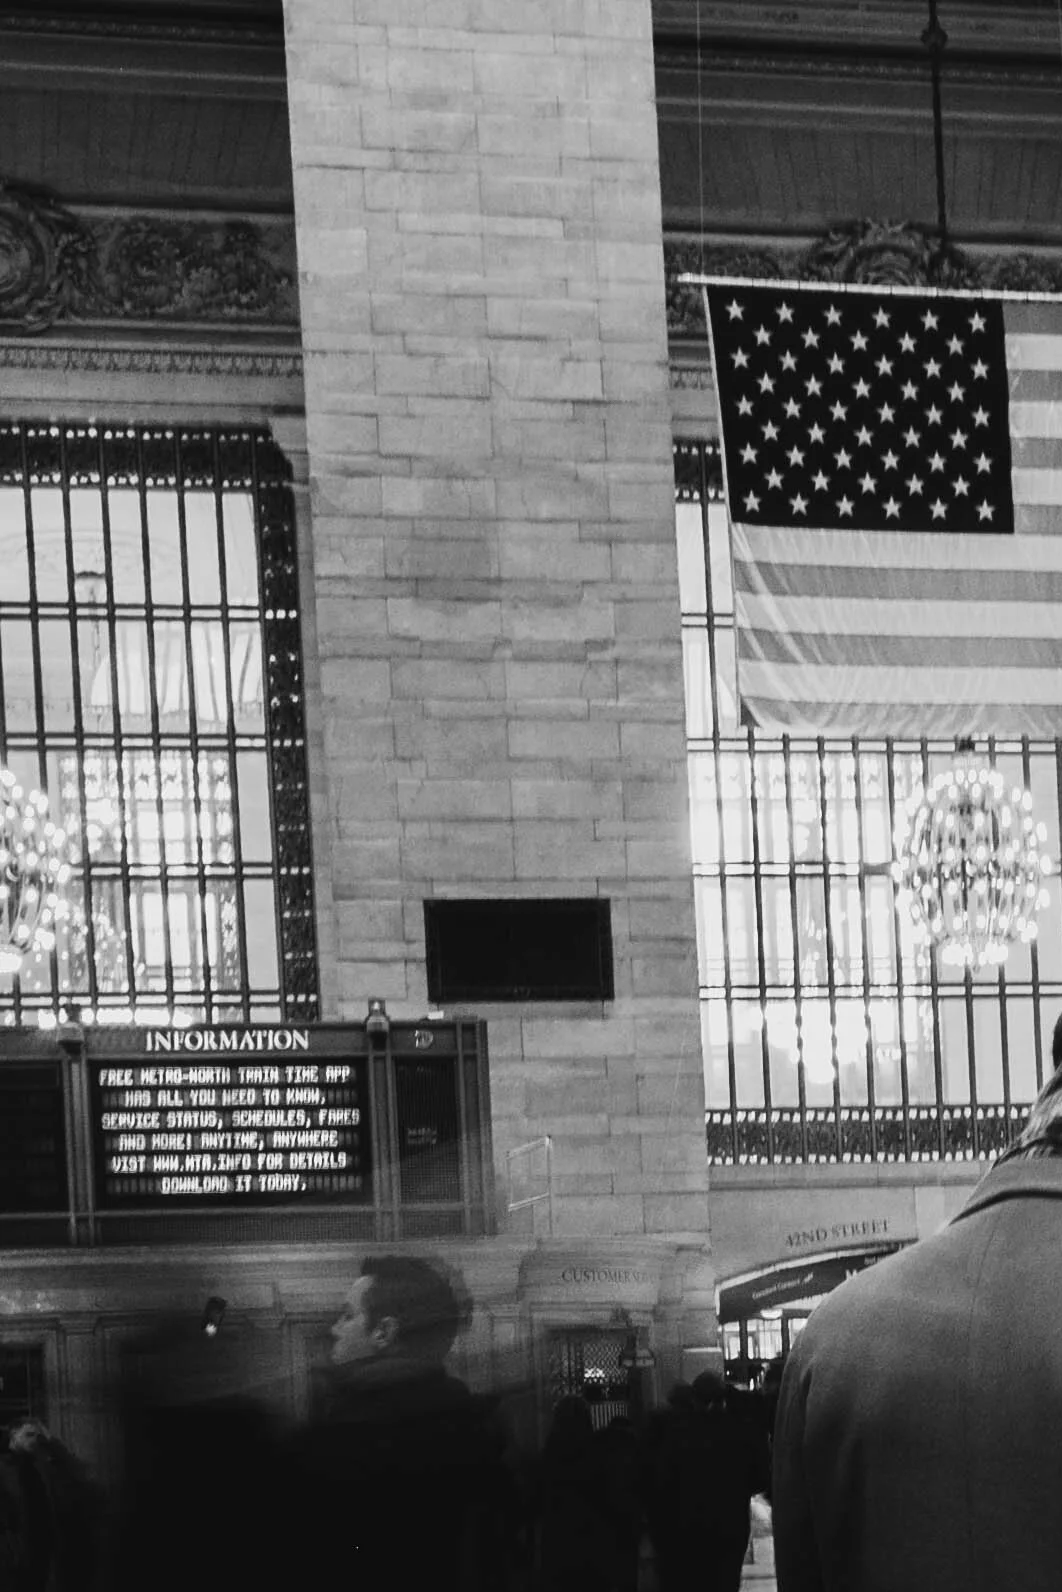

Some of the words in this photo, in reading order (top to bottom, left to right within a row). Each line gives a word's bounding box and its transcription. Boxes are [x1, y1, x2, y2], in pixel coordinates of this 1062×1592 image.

[146, 1030, 309, 1051] INFORMATION
[98, 1068, 134, 1086] FREE
[140, 1066, 231, 1085] METRO-NORTH
[285, 1065, 319, 1083] TIME
[325, 1065, 351, 1083] APP
[157, 1089, 184, 1107] ALL
[189, 1088, 216, 1106] YOU
[262, 1087, 280, 1106] TO
[257, 1152, 284, 1171] FOR
[289, 1151, 347, 1170] DETAILS
[161, 1175, 228, 1194] DOWNLOAD
[235, 1174, 253, 1192] IT
[561, 1268, 631, 1283] CUSTOMER
